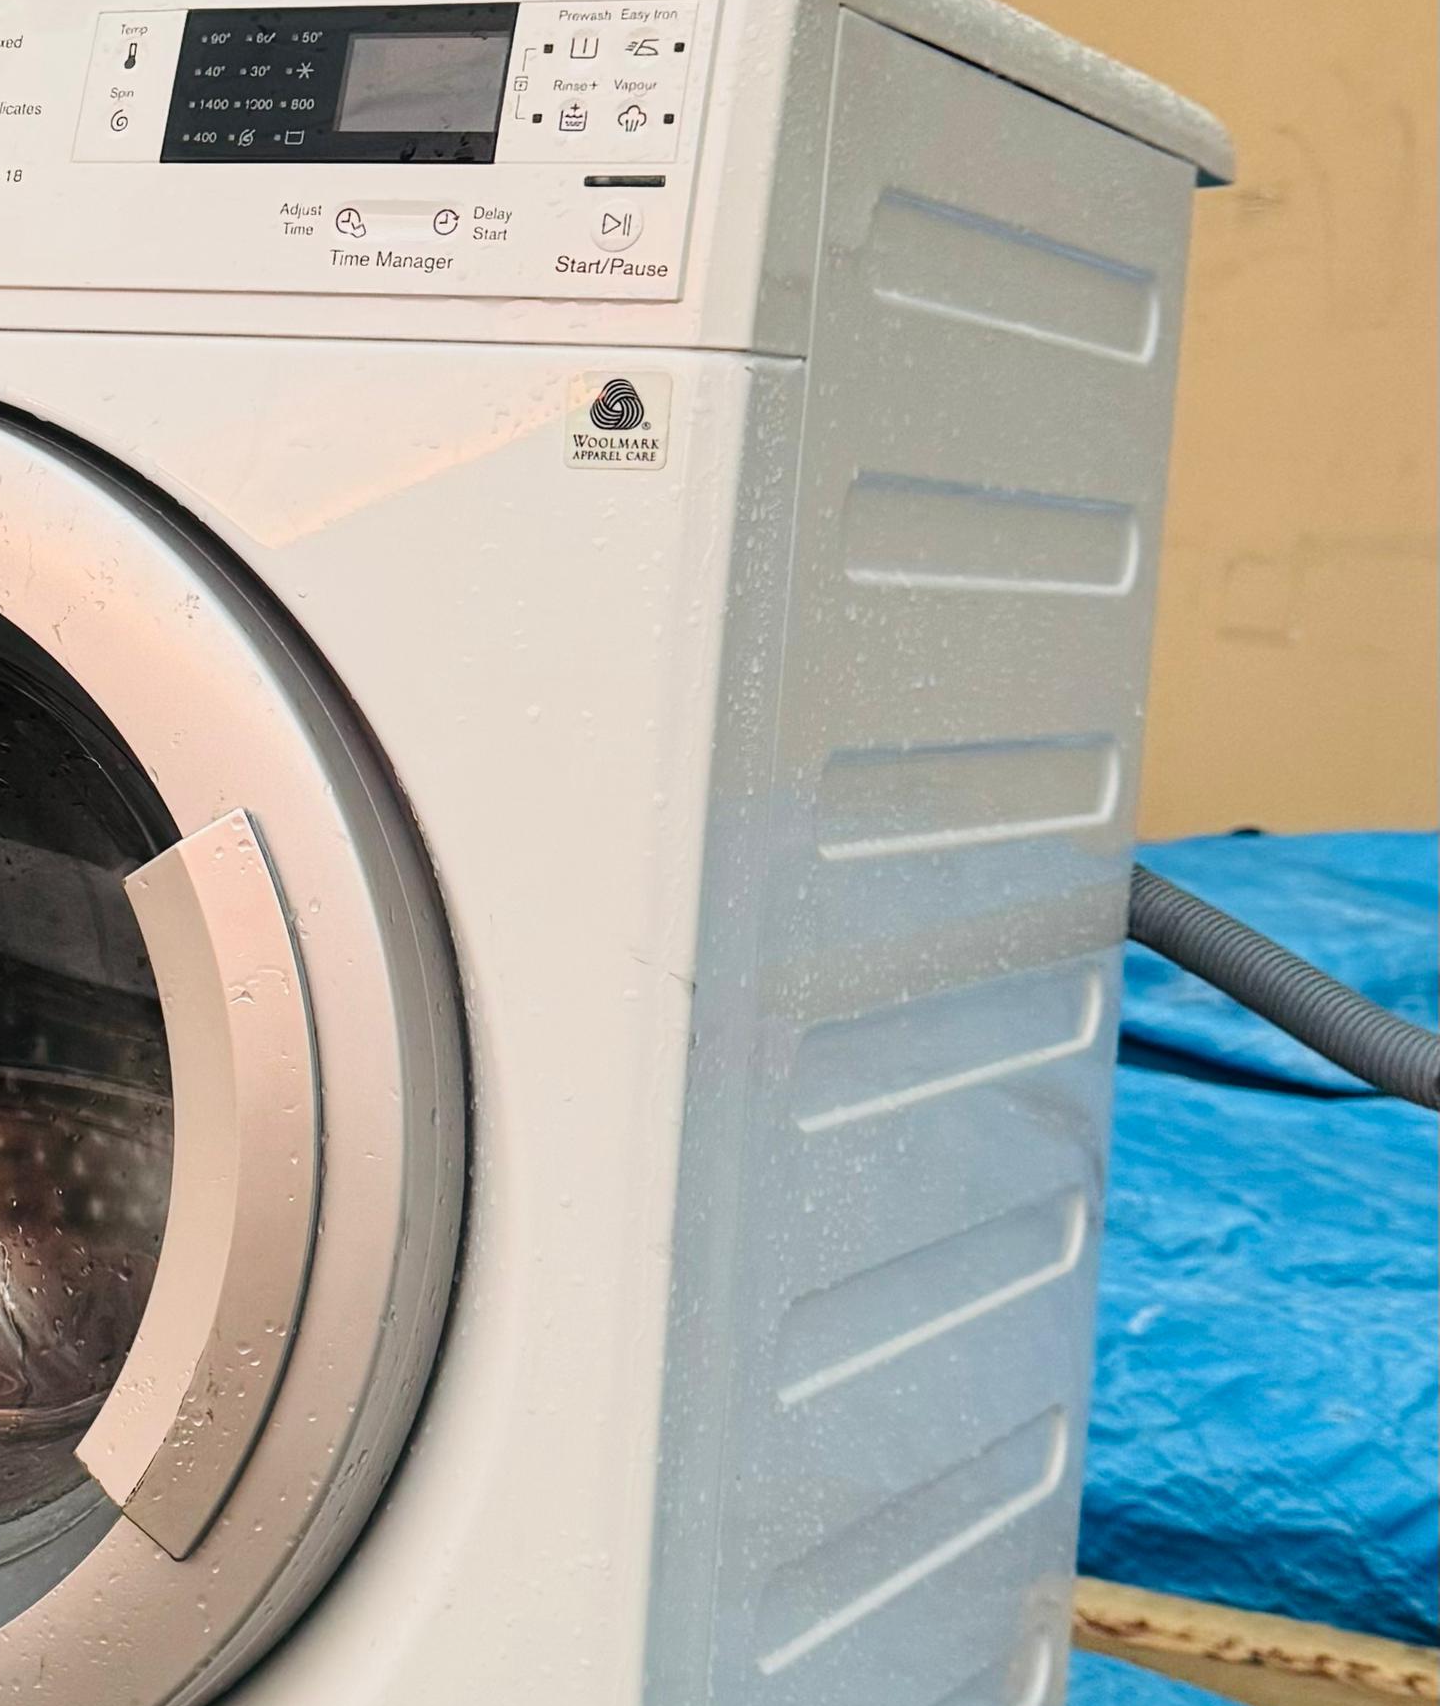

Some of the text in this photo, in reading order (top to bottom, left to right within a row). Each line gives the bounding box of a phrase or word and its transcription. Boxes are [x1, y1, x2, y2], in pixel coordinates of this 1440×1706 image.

[558, 8, 678, 22] Prewash Easy Iron
[120, 23, 148, 37] Temp
[614, 79, 657, 93] Vapour
[110, 87, 135, 100] Spin
[200, 99, 229, 110] 1400
[245, 98, 273, 110] 1000
[193, 131, 217, 143] 400
[6, 168, 23, 183] 18
[279, 201, 322, 218] Adjust
[473, 206, 513, 224] Delay
[283, 222, 314, 236] Time
[472, 227, 508, 242] Start
[329, 249, 454, 272] Time Manager
[554, 254, 669, 278] Start/Pause
[572, 450, 657, 462] APPAREL CARE
